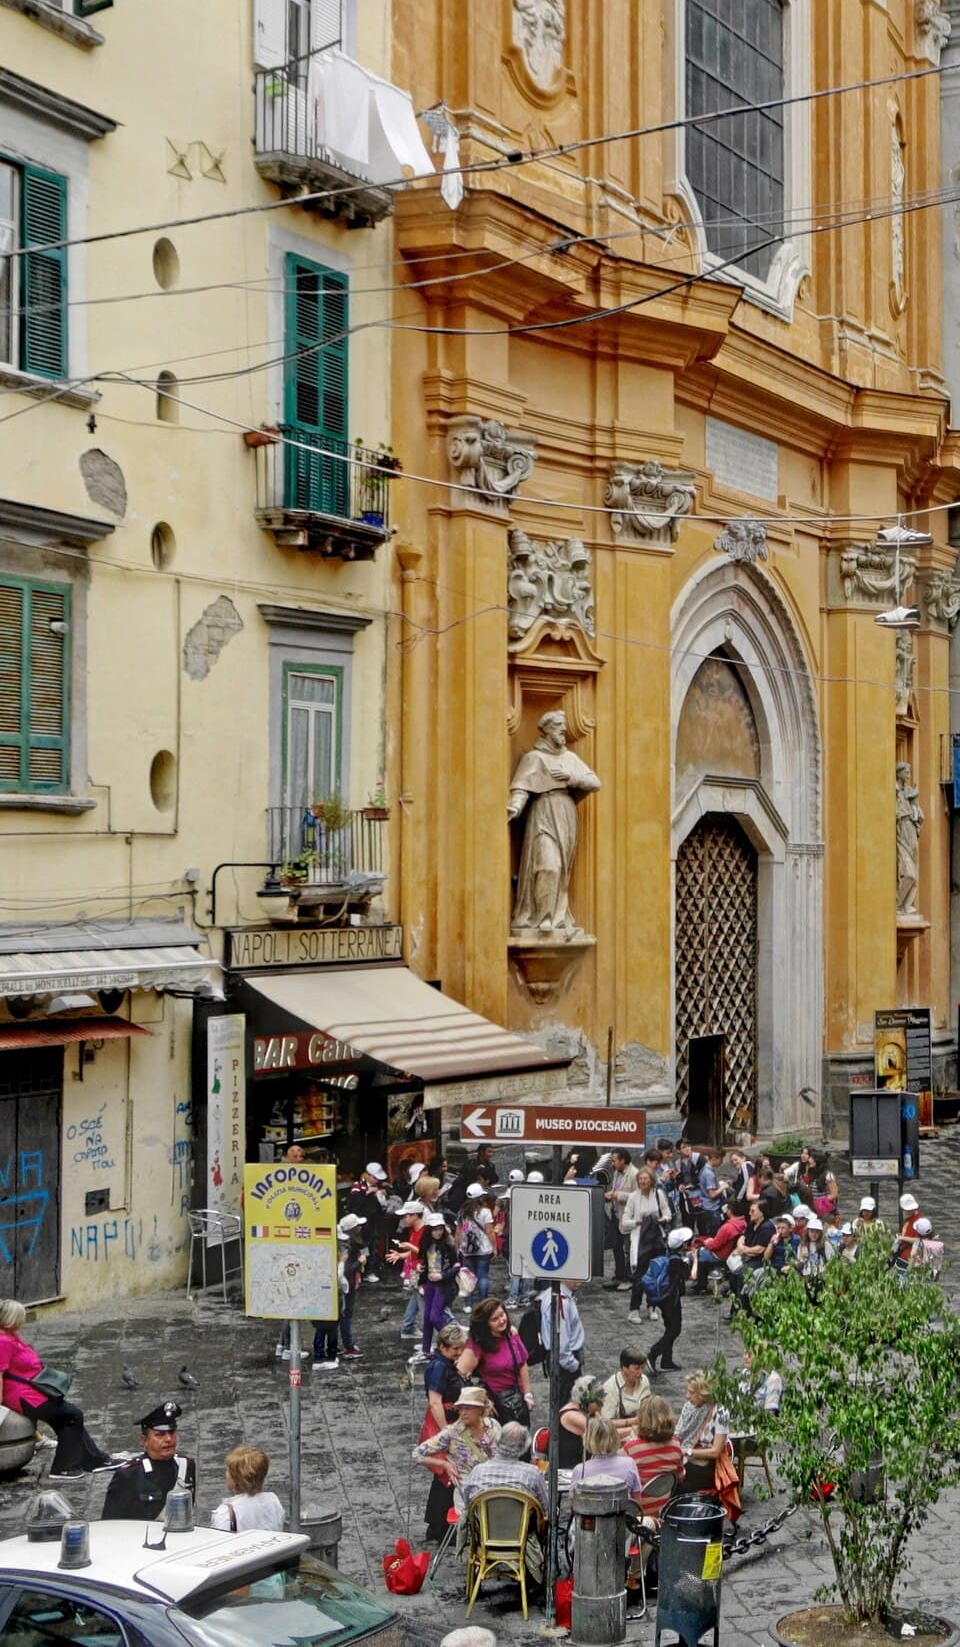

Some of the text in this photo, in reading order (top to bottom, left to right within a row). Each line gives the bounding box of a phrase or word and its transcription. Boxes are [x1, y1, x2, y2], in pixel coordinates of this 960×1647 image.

[231, 928, 401, 965] NAPOLI SOTTERRANEA
[254, 1036, 298, 1071] BAR
[230, 1059, 240, 1185] PIZZERIA
[535, 1118, 637, 1133] MUSEO DIOCESANO
[265, 1185, 321, 1212] POLIZIA MUNICIPALE
[539, 1194, 561, 1205] AREA
[527, 1210, 572, 1223] PEDONALE
